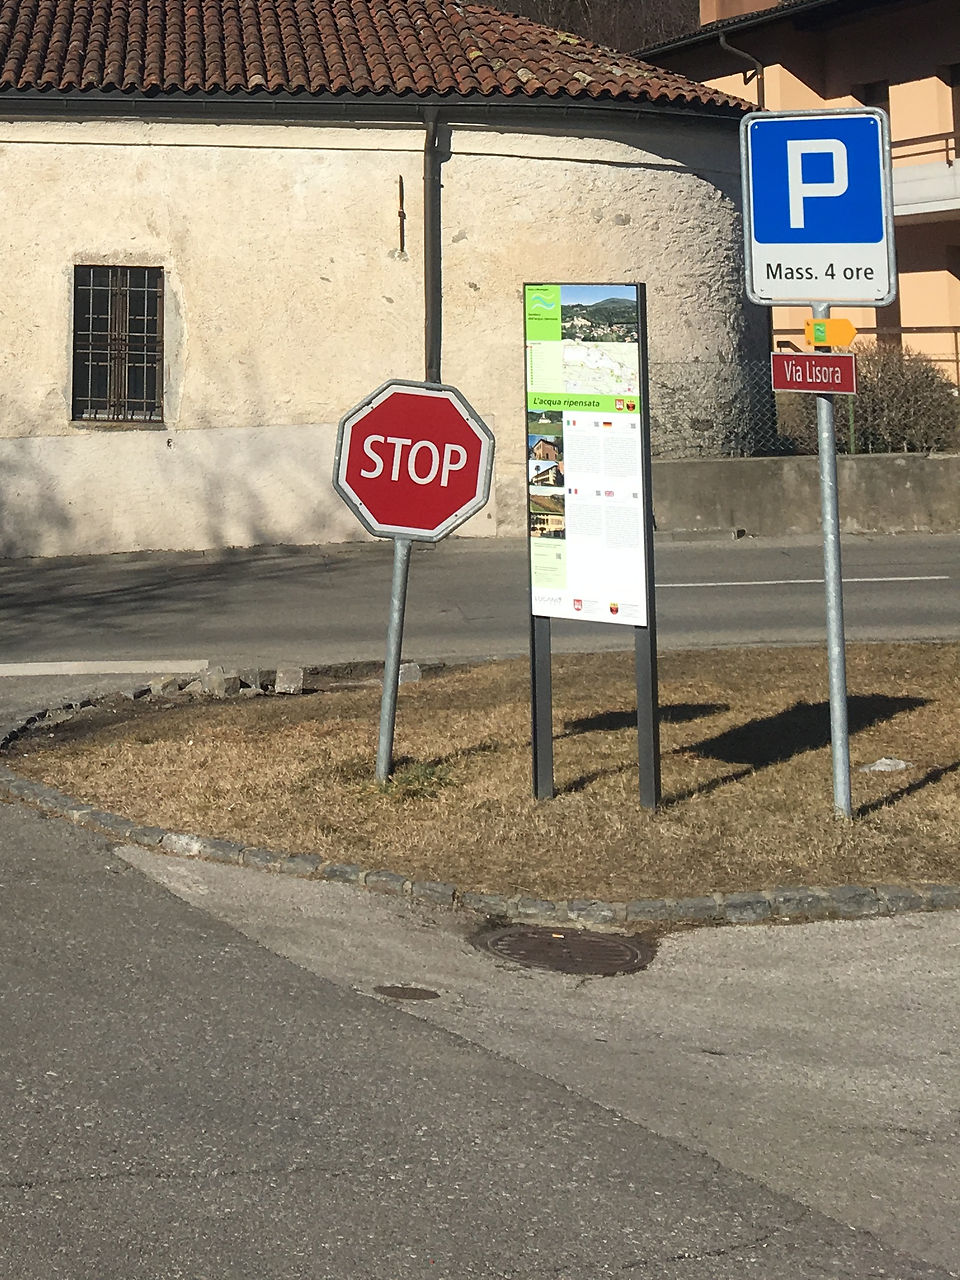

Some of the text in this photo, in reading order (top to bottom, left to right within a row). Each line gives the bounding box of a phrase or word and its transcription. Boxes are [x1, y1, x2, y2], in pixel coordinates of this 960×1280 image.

[786, 138, 849, 229] P
[766, 263, 874, 280] Mass. 4 ore
[783, 360, 842, 384] Via Lisora
[533, 397, 600, 408] L'acqua ripensata
[360, 434, 468, 487] STOP
